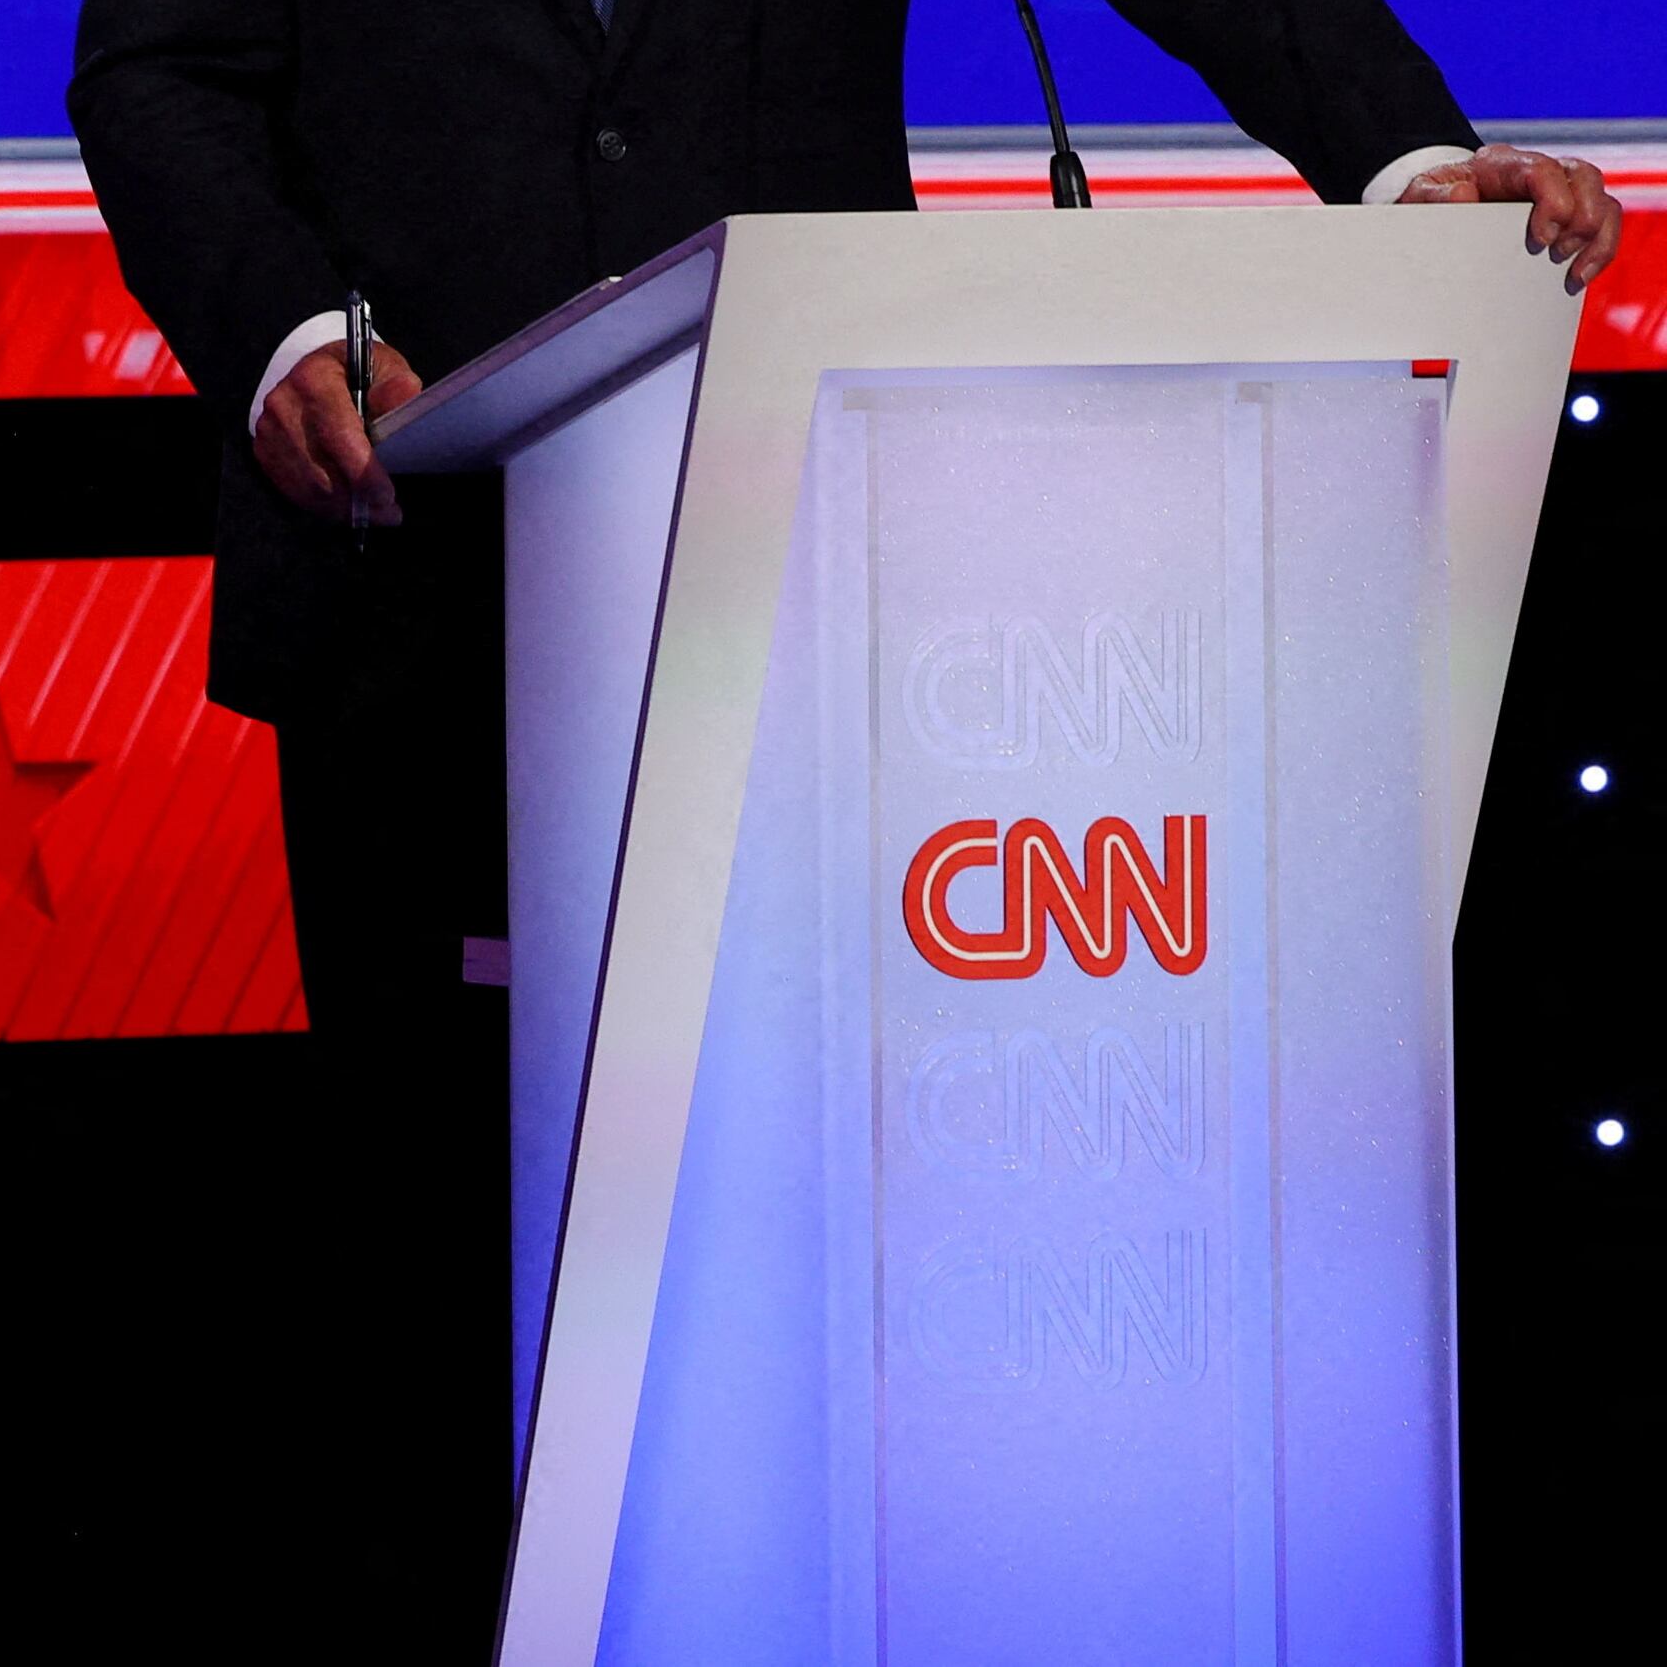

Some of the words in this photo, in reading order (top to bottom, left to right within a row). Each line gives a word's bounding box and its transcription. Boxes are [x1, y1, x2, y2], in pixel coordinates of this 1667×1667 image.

[901, 608, 1204, 771] CNN
[901, 813, 1210, 981] CNN
[905, 1021, 1208, 1184] CNN
[907, 1226, 1209, 1397] CNN
